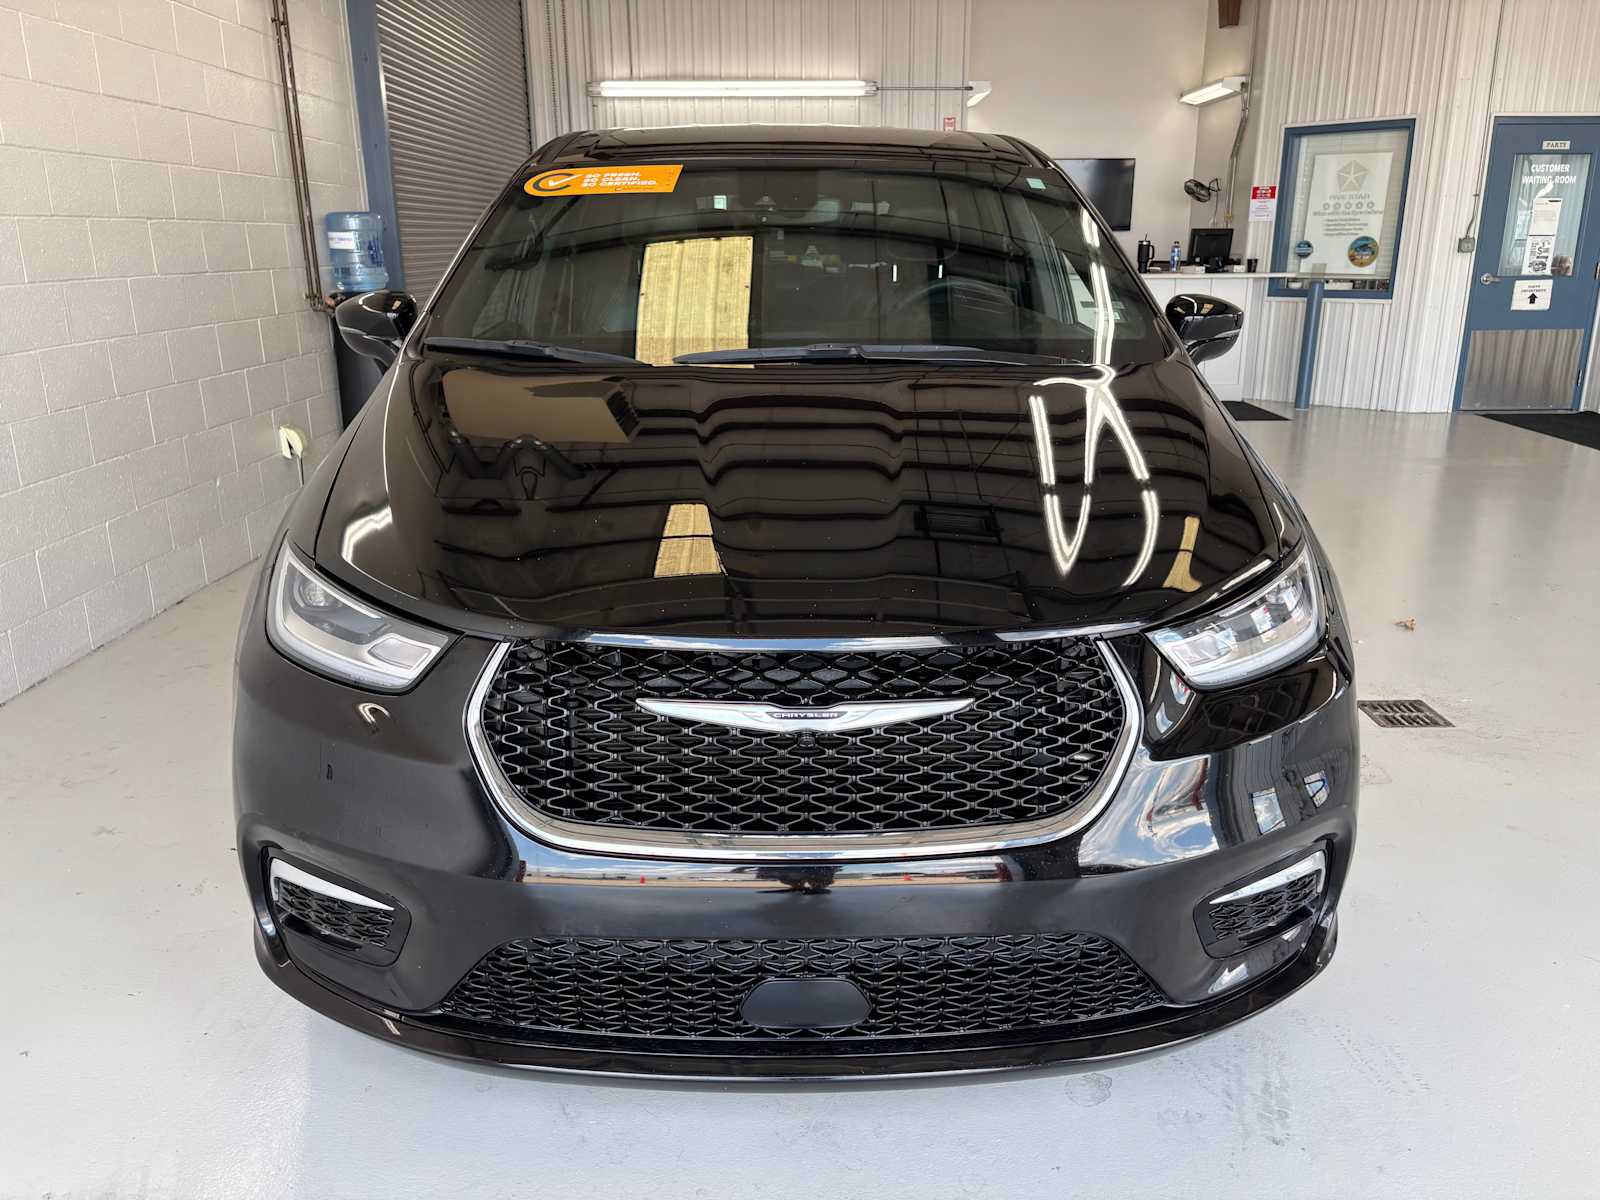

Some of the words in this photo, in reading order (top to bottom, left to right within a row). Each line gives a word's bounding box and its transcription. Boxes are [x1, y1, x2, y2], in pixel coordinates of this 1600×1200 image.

[1531, 164, 1570, 172] CUSTOMER
[1522, 176, 1553, 184] WAITING
[1554, 176, 1577, 184] ROOM
